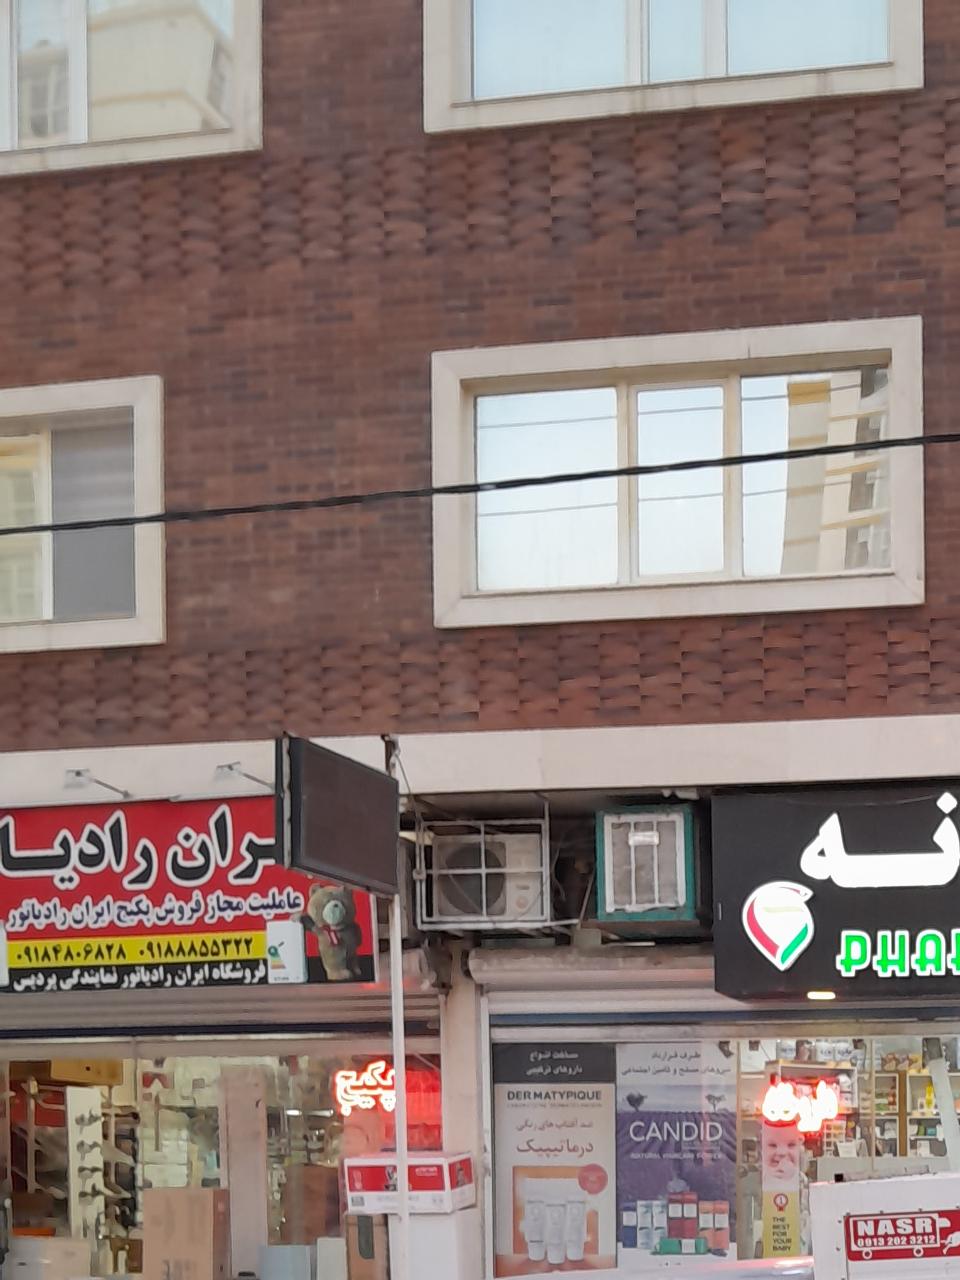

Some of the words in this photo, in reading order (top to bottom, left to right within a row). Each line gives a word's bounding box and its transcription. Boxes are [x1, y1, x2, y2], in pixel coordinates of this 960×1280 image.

[165, 803, 276, 886] ران
[6, 896, 72, 932] رادیاتور
[72, 895, 114, 929] ایران
[154, 890, 204, 926] فروش
[204, 889, 246, 922] مجاز
[246, 886, 304, 919] عاملیت
[13, 971, 58, 991] پردیس
[60, 966, 119, 986] نمایندگی
[121, 964, 172, 988] رادیاتور
[174, 964, 210, 986] ایران
[211, 960, 266, 984] فروشگاه
[507, 1090, 602, 1101] DERMATYPIQUE
[629, 1121, 723, 1142] CANDID
[857, 1217, 933, 1236] NASR
[887, 1236, 908, 1246] 202
[909, 1234, 936, 1245] 3212
